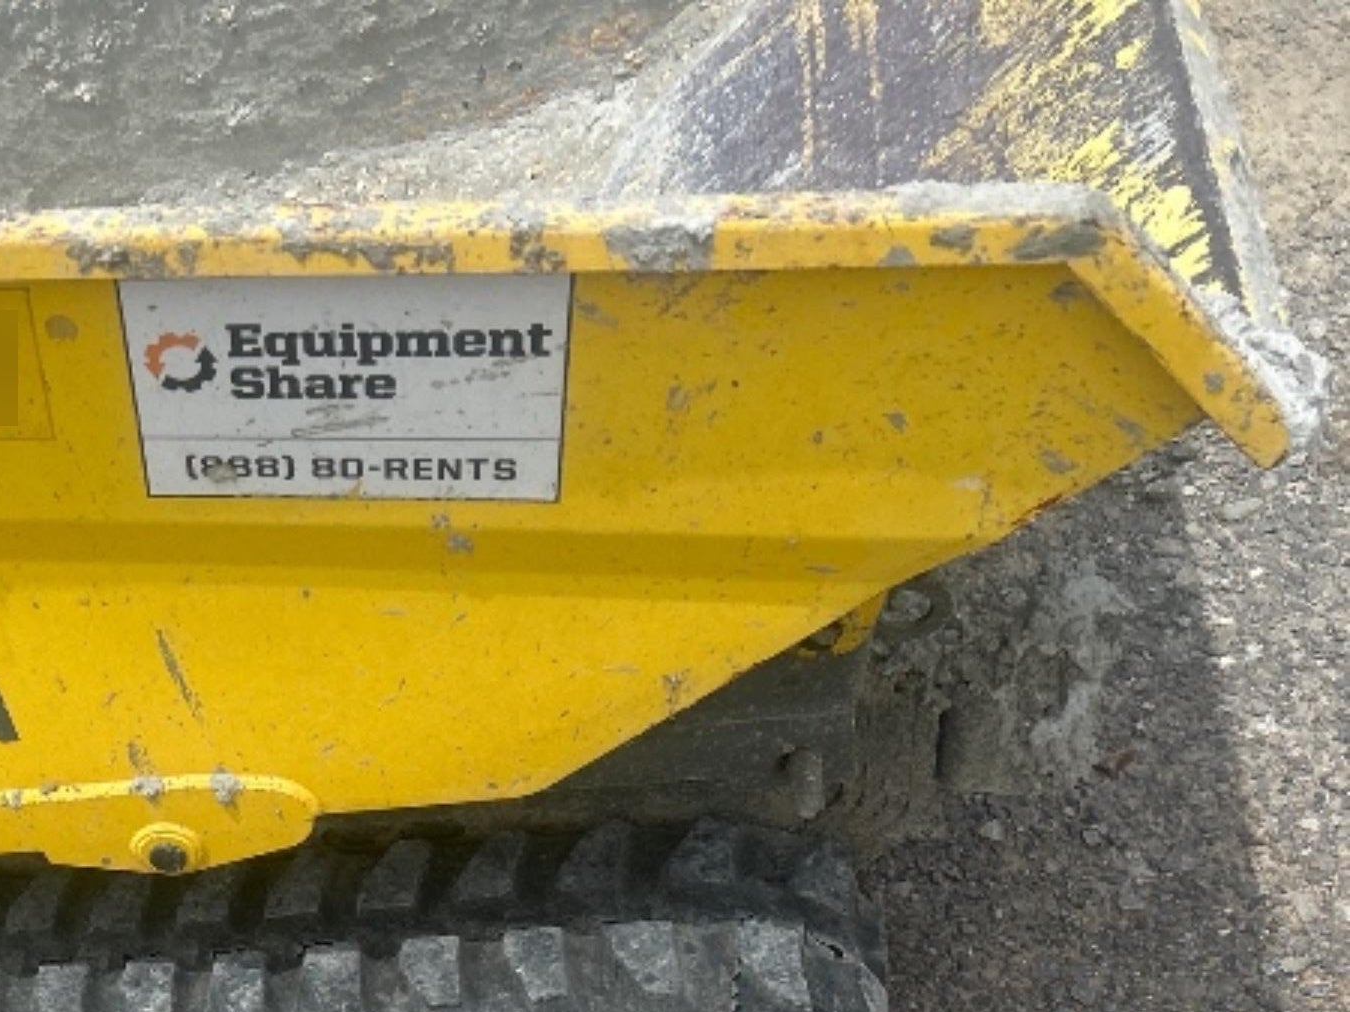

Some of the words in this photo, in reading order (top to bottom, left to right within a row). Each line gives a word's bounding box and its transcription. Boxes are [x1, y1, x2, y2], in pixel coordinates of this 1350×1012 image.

[224, 322, 553, 366] Equipment
[229, 366, 398, 400] Share
[185, 454, 296, 481] (888)
[310, 457, 518, 481] 80-RENTS
